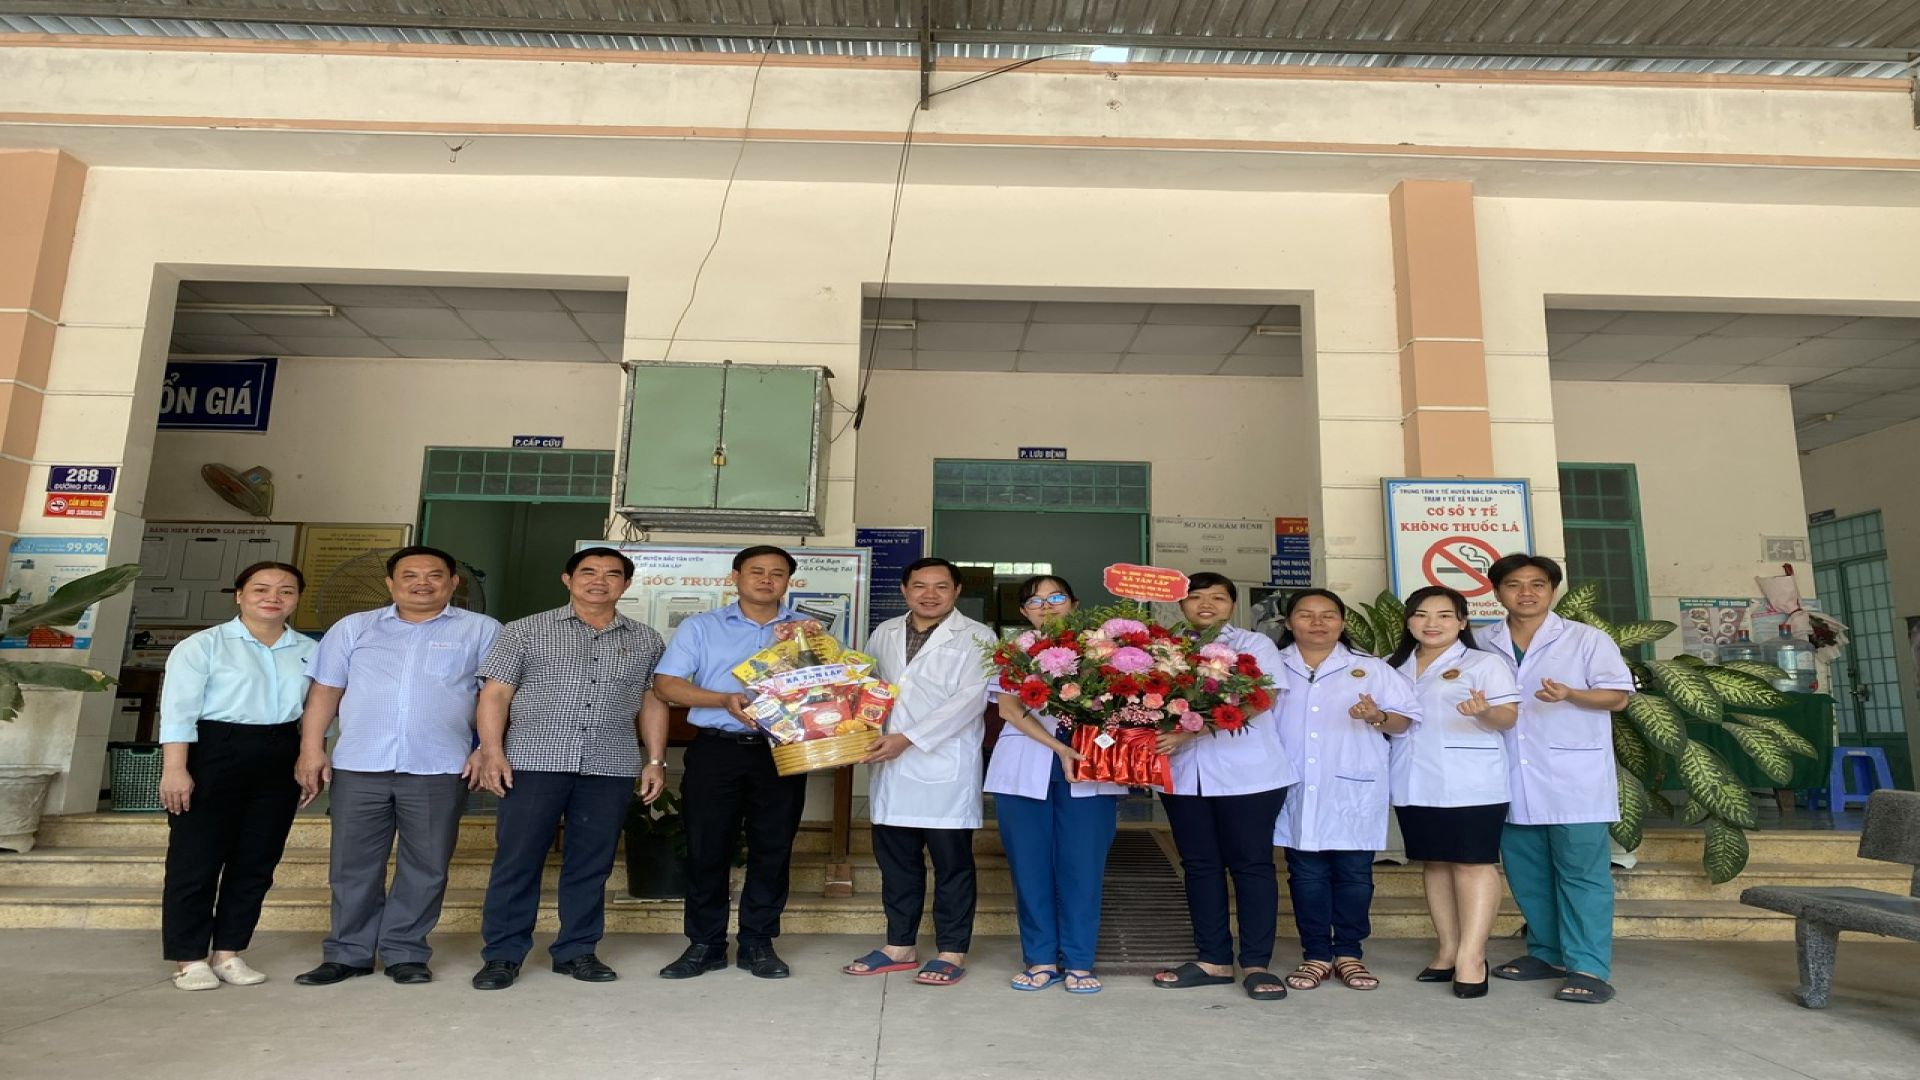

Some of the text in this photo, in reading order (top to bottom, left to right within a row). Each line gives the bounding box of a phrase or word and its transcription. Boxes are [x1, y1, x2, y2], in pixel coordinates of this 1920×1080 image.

[205, 380, 252, 415] GIÁ
[65, 468, 100, 483] 288
[1427, 503, 1498, 517] CƠ SỞ Y TẾ
[1400, 519, 1520, 532] KHÔNG THUỐC LÁ
[66, 543, 105, 553] 99.9%
[642, 574, 675, 587] GÓC
